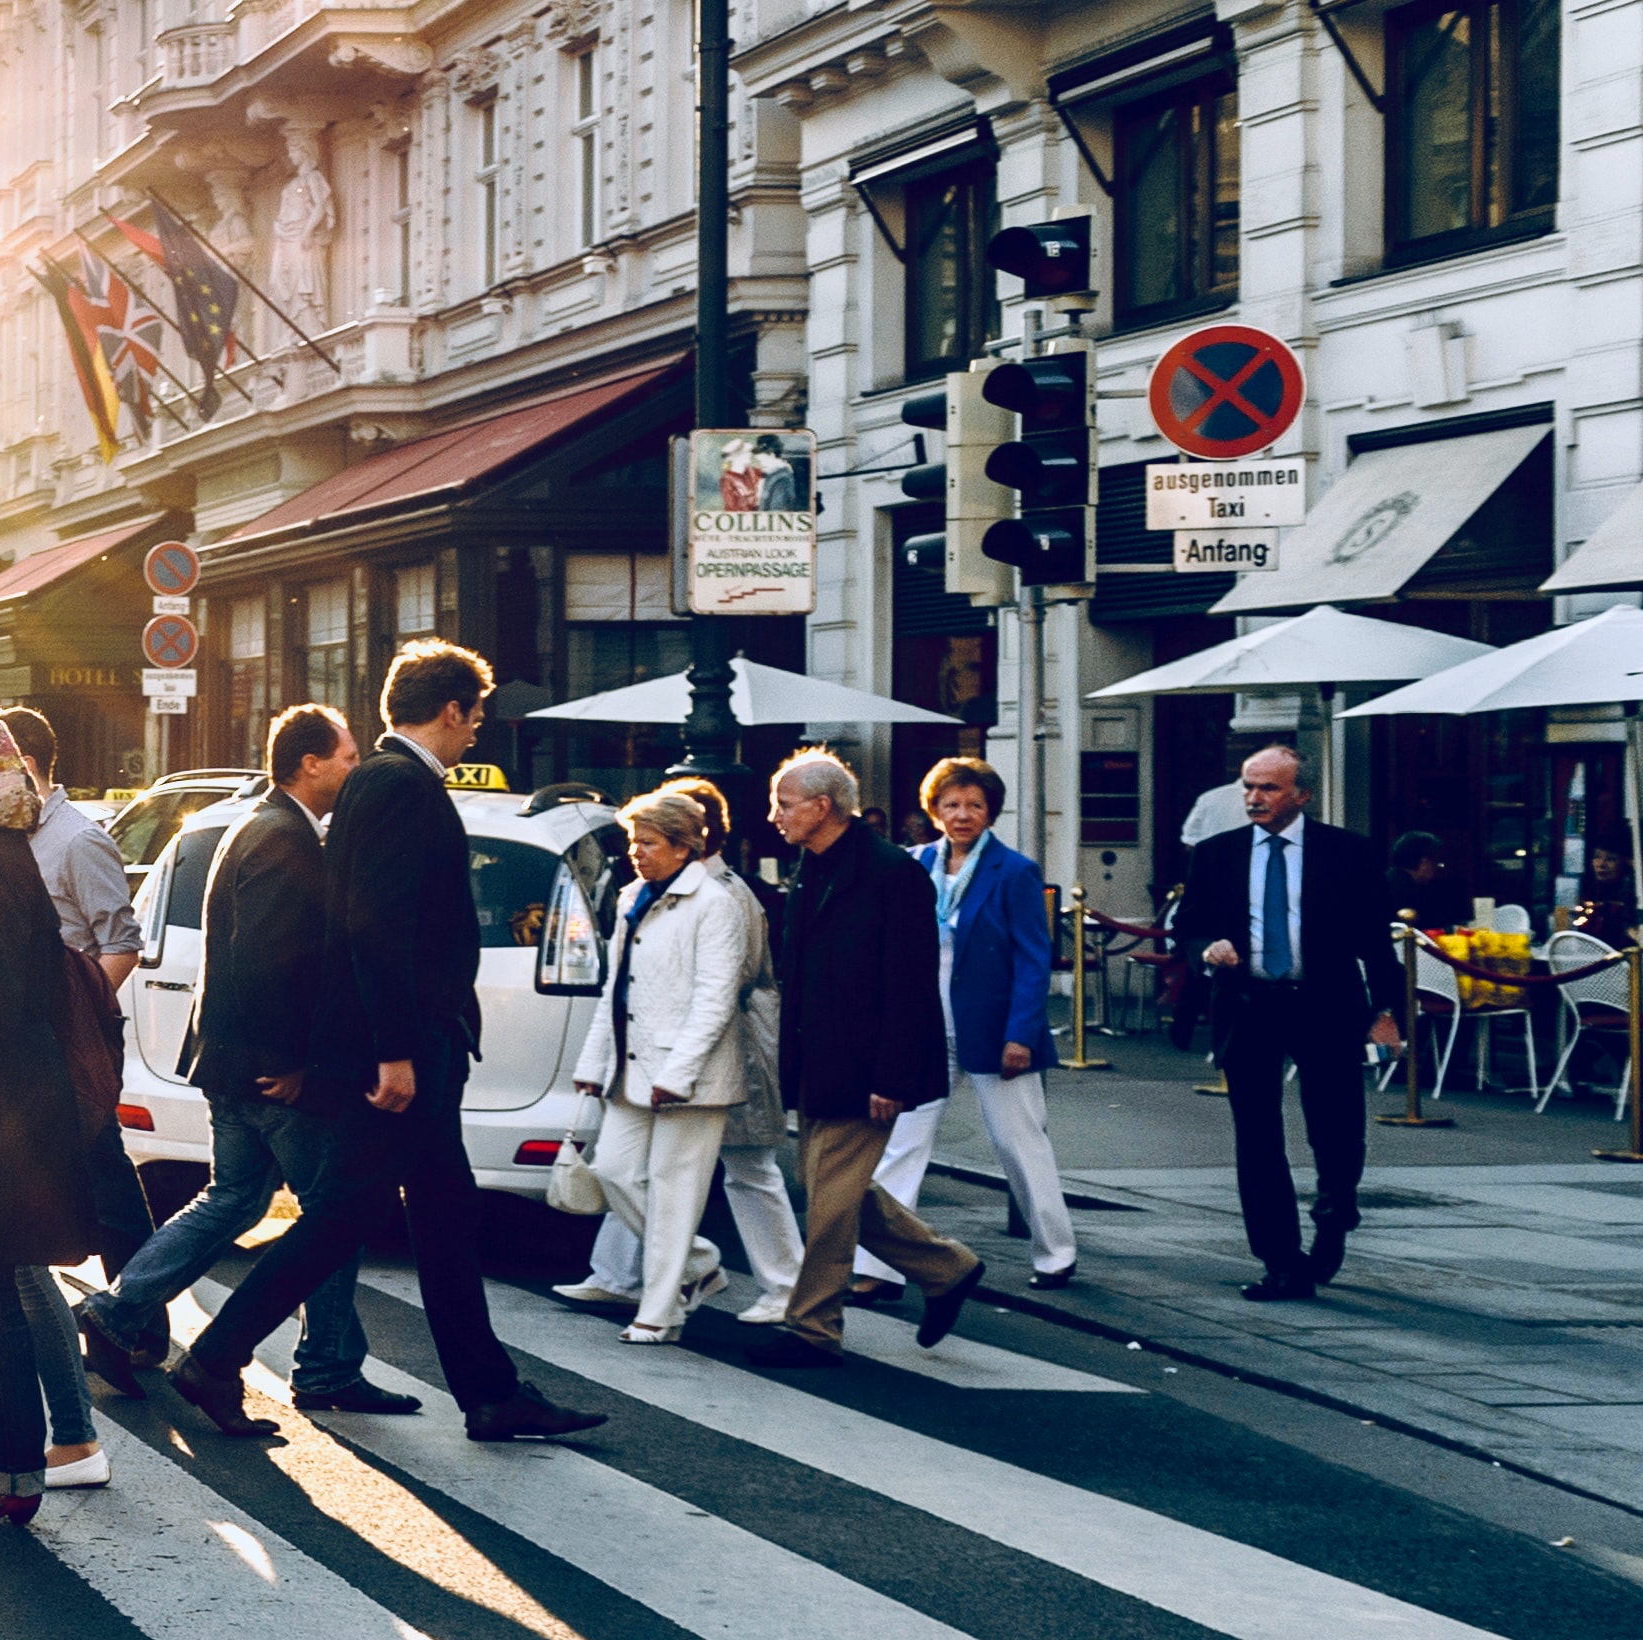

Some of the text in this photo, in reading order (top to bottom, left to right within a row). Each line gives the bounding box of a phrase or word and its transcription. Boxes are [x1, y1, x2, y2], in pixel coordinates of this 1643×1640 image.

[1153, 469, 1299, 494] ausgenommen
[1207, 496, 1245, 518] Taxi
[693, 512, 813, 533] COLLINS
[707, 549, 797, 559] AUSTRIAN LOOK
[1185, 539, 1268, 567] Anfang
[696, 562, 810, 578] OPERNPASSAGE
[49, 668, 117, 686] HOTEL
[156, 700, 181, 710] Ende
[444, 767, 490, 785] AXI
